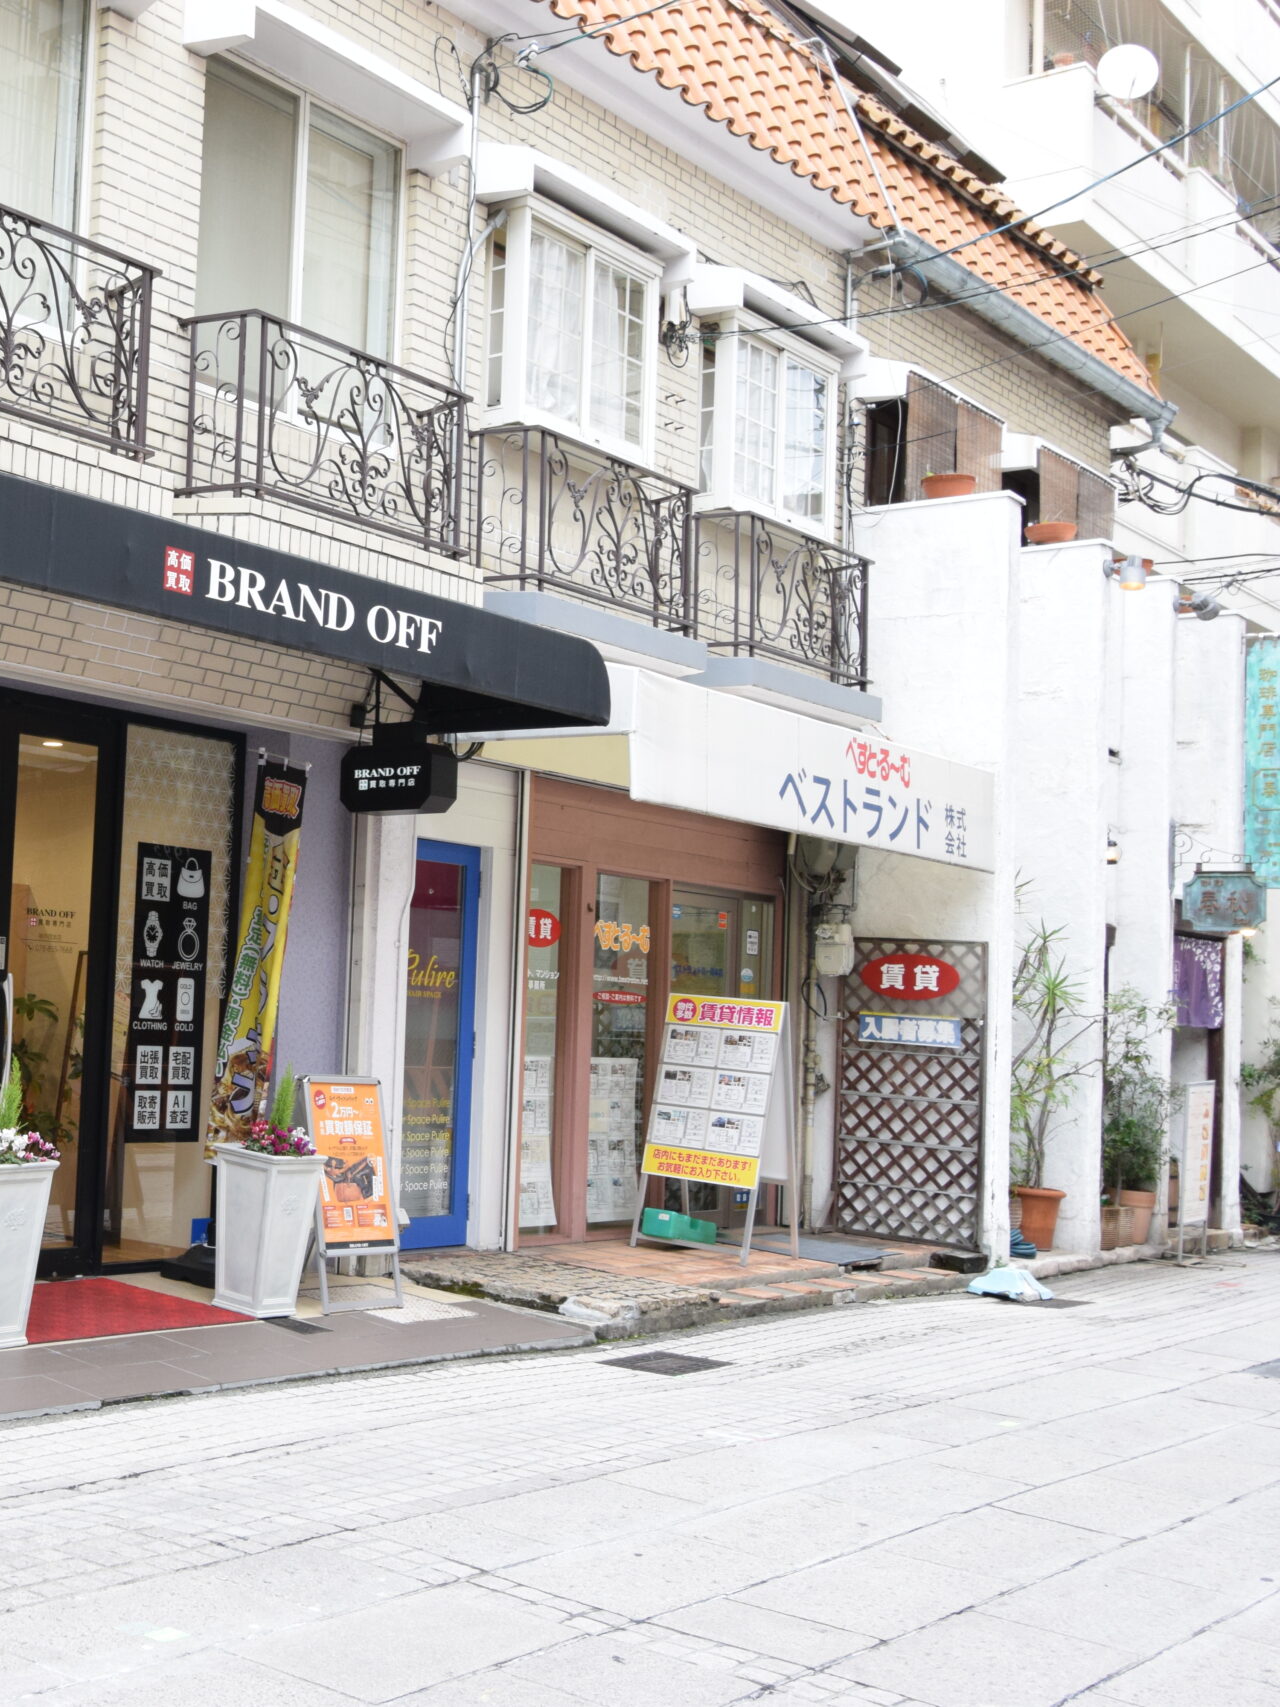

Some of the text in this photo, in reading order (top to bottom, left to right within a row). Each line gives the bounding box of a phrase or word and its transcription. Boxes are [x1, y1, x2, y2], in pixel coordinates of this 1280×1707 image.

[166, 549, 193, 571] 高価
[165, 571, 191, 593] 買取
[205, 557, 443, 654] BRAND OFF
[354, 765, 422, 779] BRAND OFF
[369, 778, 415, 789] 買取専門店
[778, 768, 932, 849] ベストランド
[945, 803, 967, 832] 株式
[945, 831, 967, 858] 会社
[145, 861, 169, 878] 高価
[144, 881, 168, 898] 買取
[183, 901, 198, 910] BAG
[26, 907, 77, 920] BRAND OFF
[140, 959, 164, 969] WATCH
[172, 961, 203, 971] JEWELRY
[880, 963, 940, 991] 賃貸
[699, 1003, 774, 1026] 賃貸情報
[132, 1022, 167, 1031] CLOTHING
[174, 1022, 194, 1032] GOLD
[140, 1050, 159, 1065] 出張
[172, 1051, 191, 1065] 宅配
[138, 1066, 158, 1080] 買取
[171, 1066, 190, 1080] 買取
[138, 1095, 158, 1109] 取寄
[173, 1095, 186, 1108] AI
[137, 1110, 157, 1125] 販売
[169, 1111, 189, 1124] 査定
[407, 1114, 430, 1124] Space
[407, 1131, 430, 1142] Space
[406, 1148, 430, 1158] Space
[652, 1149, 752, 1171] 店内にもまだまだあります!
[405, 1165, 428, 1175] Space
[656, 1162, 741, 1182] お気軽にお入り下さい。
[404, 1181, 427, 1192] Space
